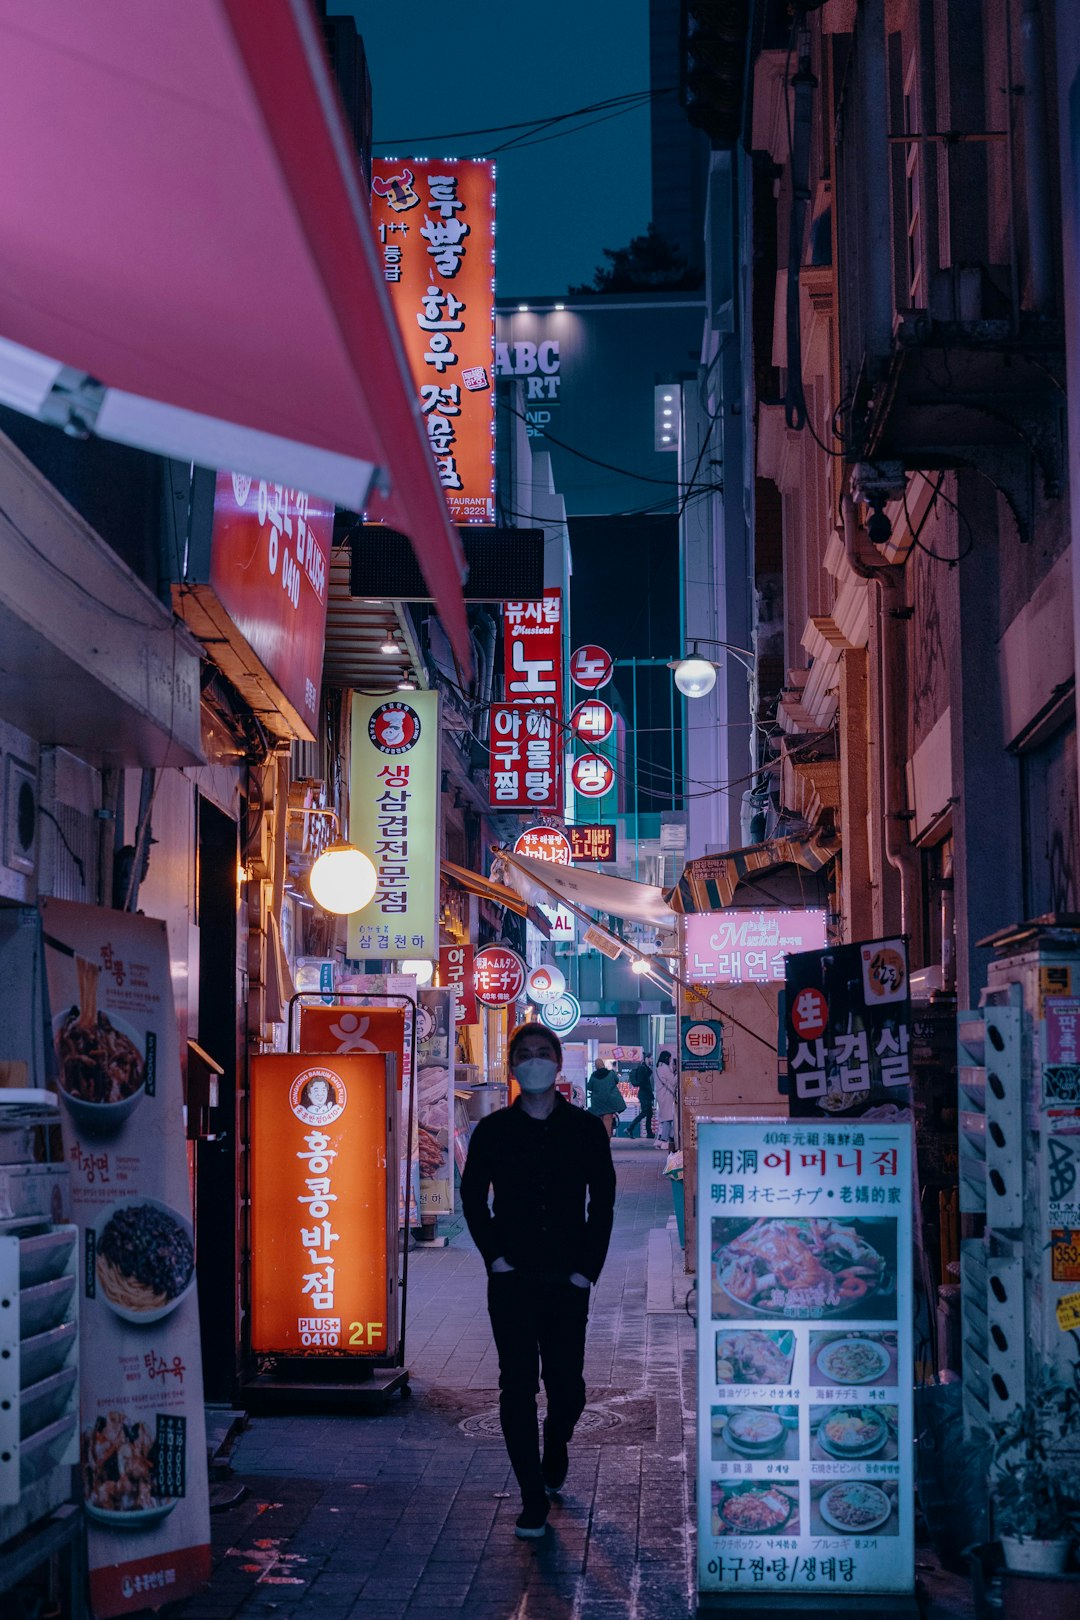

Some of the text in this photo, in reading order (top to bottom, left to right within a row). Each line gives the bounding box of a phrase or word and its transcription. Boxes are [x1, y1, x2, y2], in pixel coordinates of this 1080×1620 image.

[384, 245, 403, 281] 등급
[417, 285, 464, 371] 한우
[496, 340, 560, 375] ABC
[420, 384, 464, 489] 전문점
[282, 547, 301, 609] 0410
[511, 625, 555, 637] Musical
[494, 709, 523, 800] 아구찜
[525, 709, 553, 801] 해물탕
[523, 834, 539, 845] 명동
[571, 829, 611, 857] 노래방
[359, 934, 425, 949] 삼겹천하
[796, 992, 824, 1030] 生
[688, 1033, 714, 1046] 담배
[791, 1024, 912, 1099] 삼겹살
[712, 1148, 898, 1176] 明洞 어머니집
[296, 1129, 340, 1310] 홍콩반점
[301, 1333, 339, 1346] 0410
[348, 1321, 383, 1345] 2F
[144, 1349, 186, 1385] 탕수육
